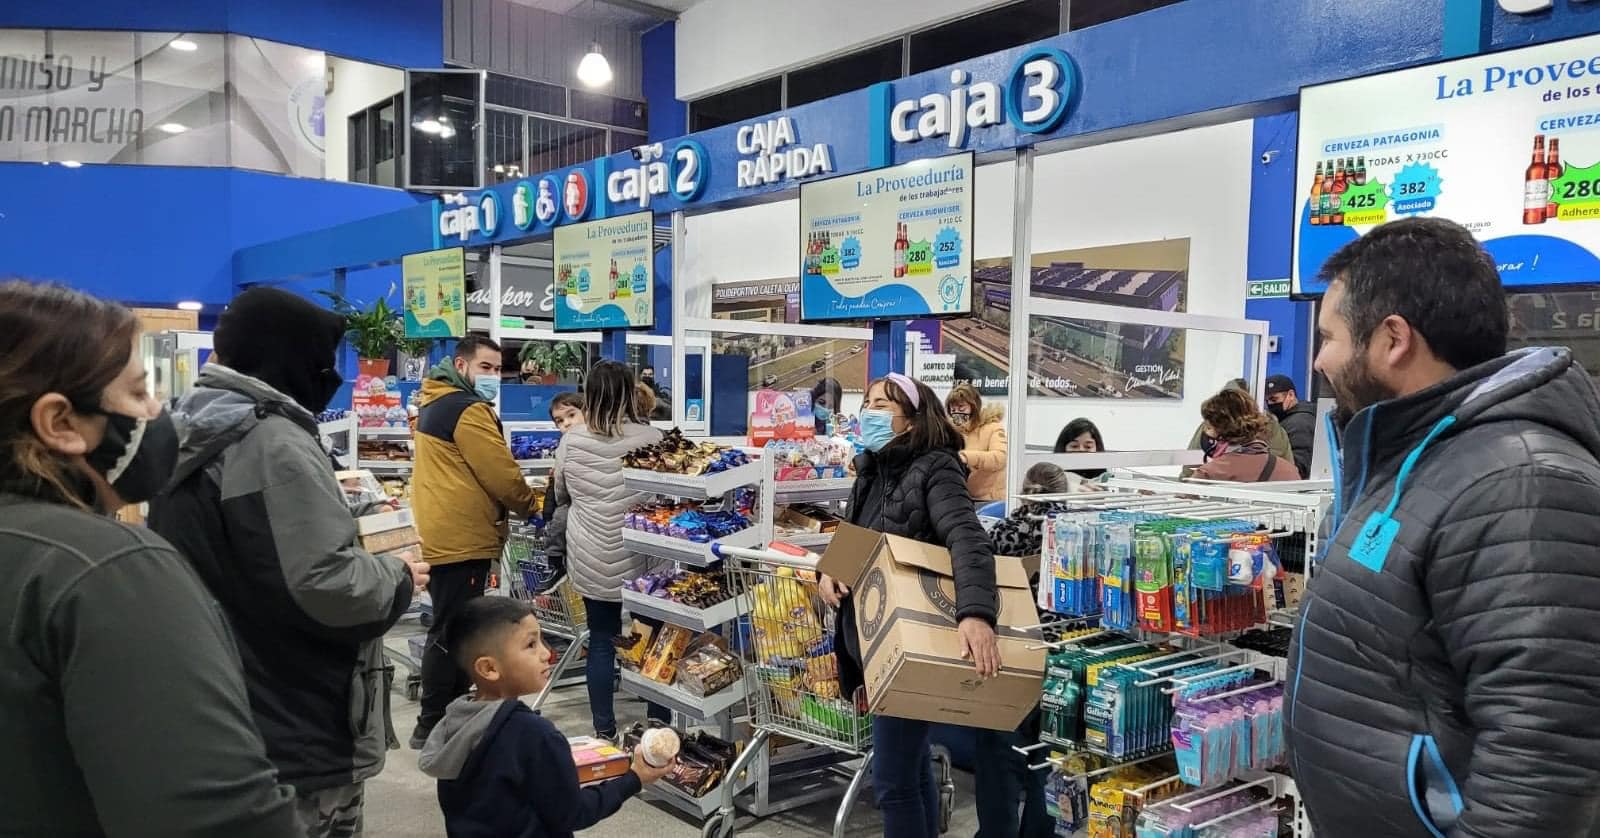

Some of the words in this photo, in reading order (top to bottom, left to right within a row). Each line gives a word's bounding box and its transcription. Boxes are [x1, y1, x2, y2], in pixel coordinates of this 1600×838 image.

[1435, 73, 1474, 100] La
[1482, 55, 1600, 93] Provee
[890, 69, 1001, 148] caja
[1022, 59, 1060, 124] 3
[1542, 90, 1562, 102] de
[1567, 87, 1590, 99] los
[24, 106, 144, 144] MARCHA
[1540, 113, 1600, 132] CERVEZA
[737, 117, 797, 156] CAJA
[1324, 139, 1370, 153] CERVEZA
[1373, 129, 1440, 147] PATAGONIA
[737, 142, 834, 189] RÁPIDA
[1368, 155, 1401, 167] TODAS
[1406, 153, 1414, 162] X
[607, 150, 669, 208] caja
[677, 148, 699, 194] 2
[856, 181, 872, 198] La
[877, 164, 965, 194] Proveeduría
[1399, 181, 1426, 195] 382
[1562, 180, 1600, 199] 280
[1347, 193, 1376, 209] 425
[440, 199, 479, 241] caja
[481, 197, 497, 231] 1
[1346, 213, 1384, 223] Adherente
[939, 241, 955, 252] 252
[909, 250, 926, 263] 280
[715, 285, 758, 300] POLIDEPORTIVO
[760, 283, 782, 296] CALETA
[923, 362, 943, 371] SORTEO
[1135, 362, 1162, 373] GESTIÓN
[972, 378, 982, 387] en
[1030, 376, 1041, 388] de
